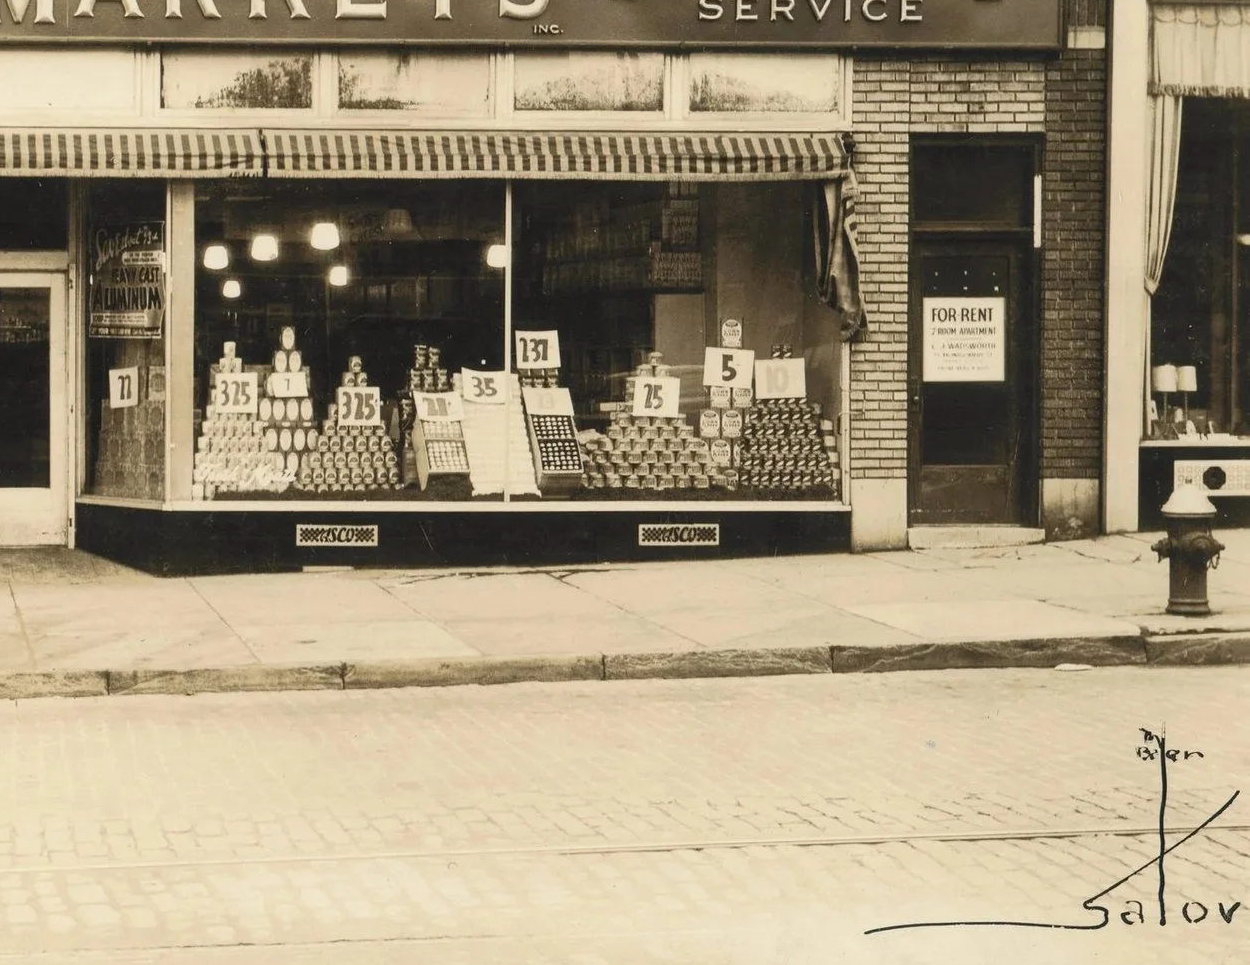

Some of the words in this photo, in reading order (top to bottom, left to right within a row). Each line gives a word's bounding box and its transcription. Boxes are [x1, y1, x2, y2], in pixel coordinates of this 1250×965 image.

[533, 24, 564, 34] INC.
[138, 266, 160, 284] CAST
[92, 279, 162, 311] ALUMINUM
[931, 307, 957, 323] FOR
[961, 307, 994, 323] RENT
[937, 326, 957, 335] ROOM
[959, 326, 997, 336] APARTMENT
[722, 353, 737, 382] 5
[472, 376, 498, 397] 35
[765, 365, 789, 394] 10
[643, 383, 664, 410] 25
[319, 526, 355, 544] ASCO
[661, 526, 697, 543] ASCO
